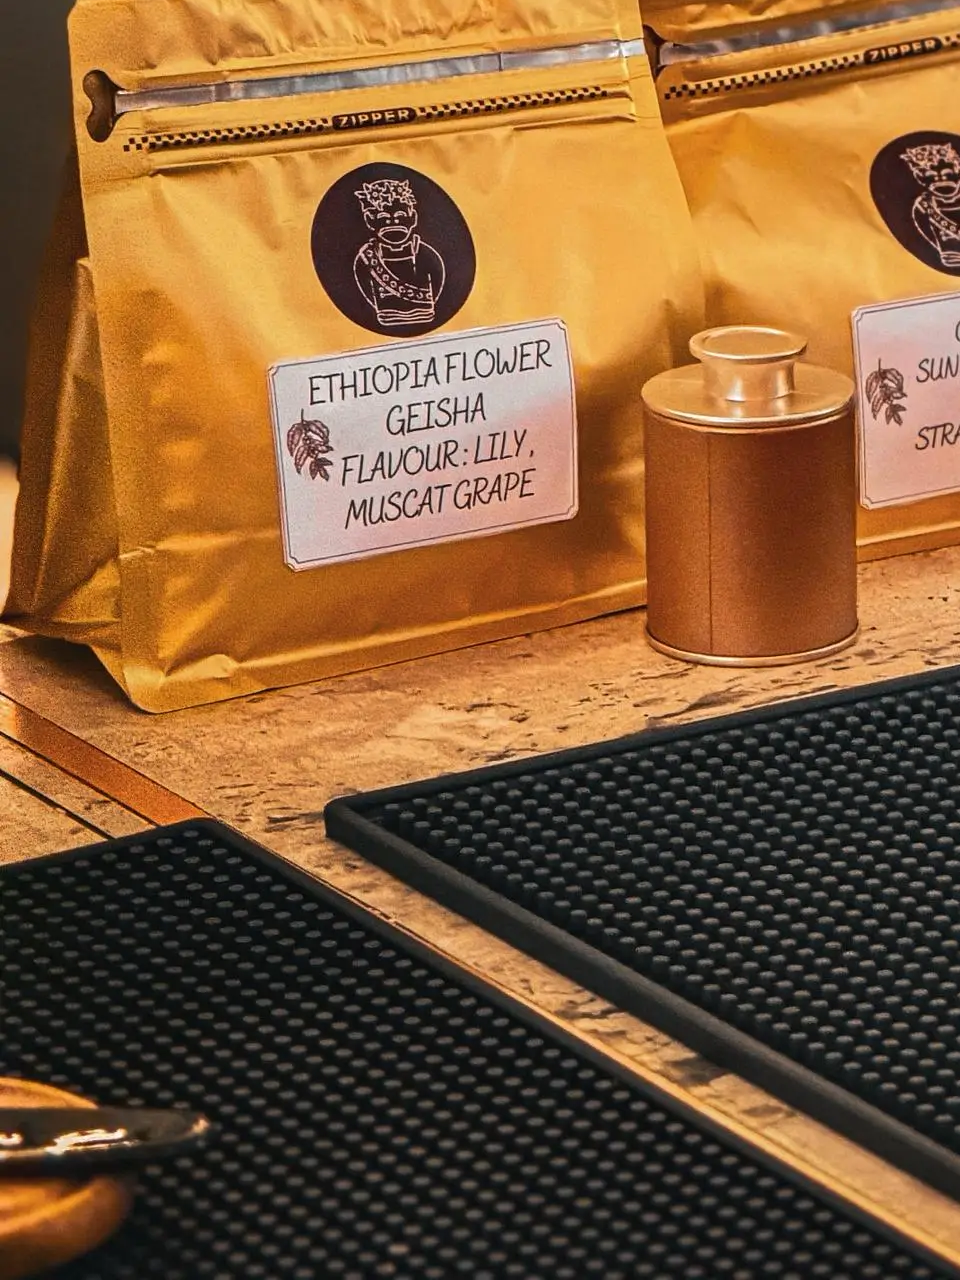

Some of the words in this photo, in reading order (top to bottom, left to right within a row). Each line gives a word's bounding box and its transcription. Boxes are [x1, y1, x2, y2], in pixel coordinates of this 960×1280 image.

[869, 39, 937, 61] ZIPPER
[338, 109, 410, 128] ZIPPER
[308, 357, 440, 405] ETHIOPIA
[445, 339, 552, 384] FLOWER
[386, 393, 487, 436] GEISHA
[345, 484, 452, 530] MUSCAT
[453, 468, 537, 511] GRAPE
